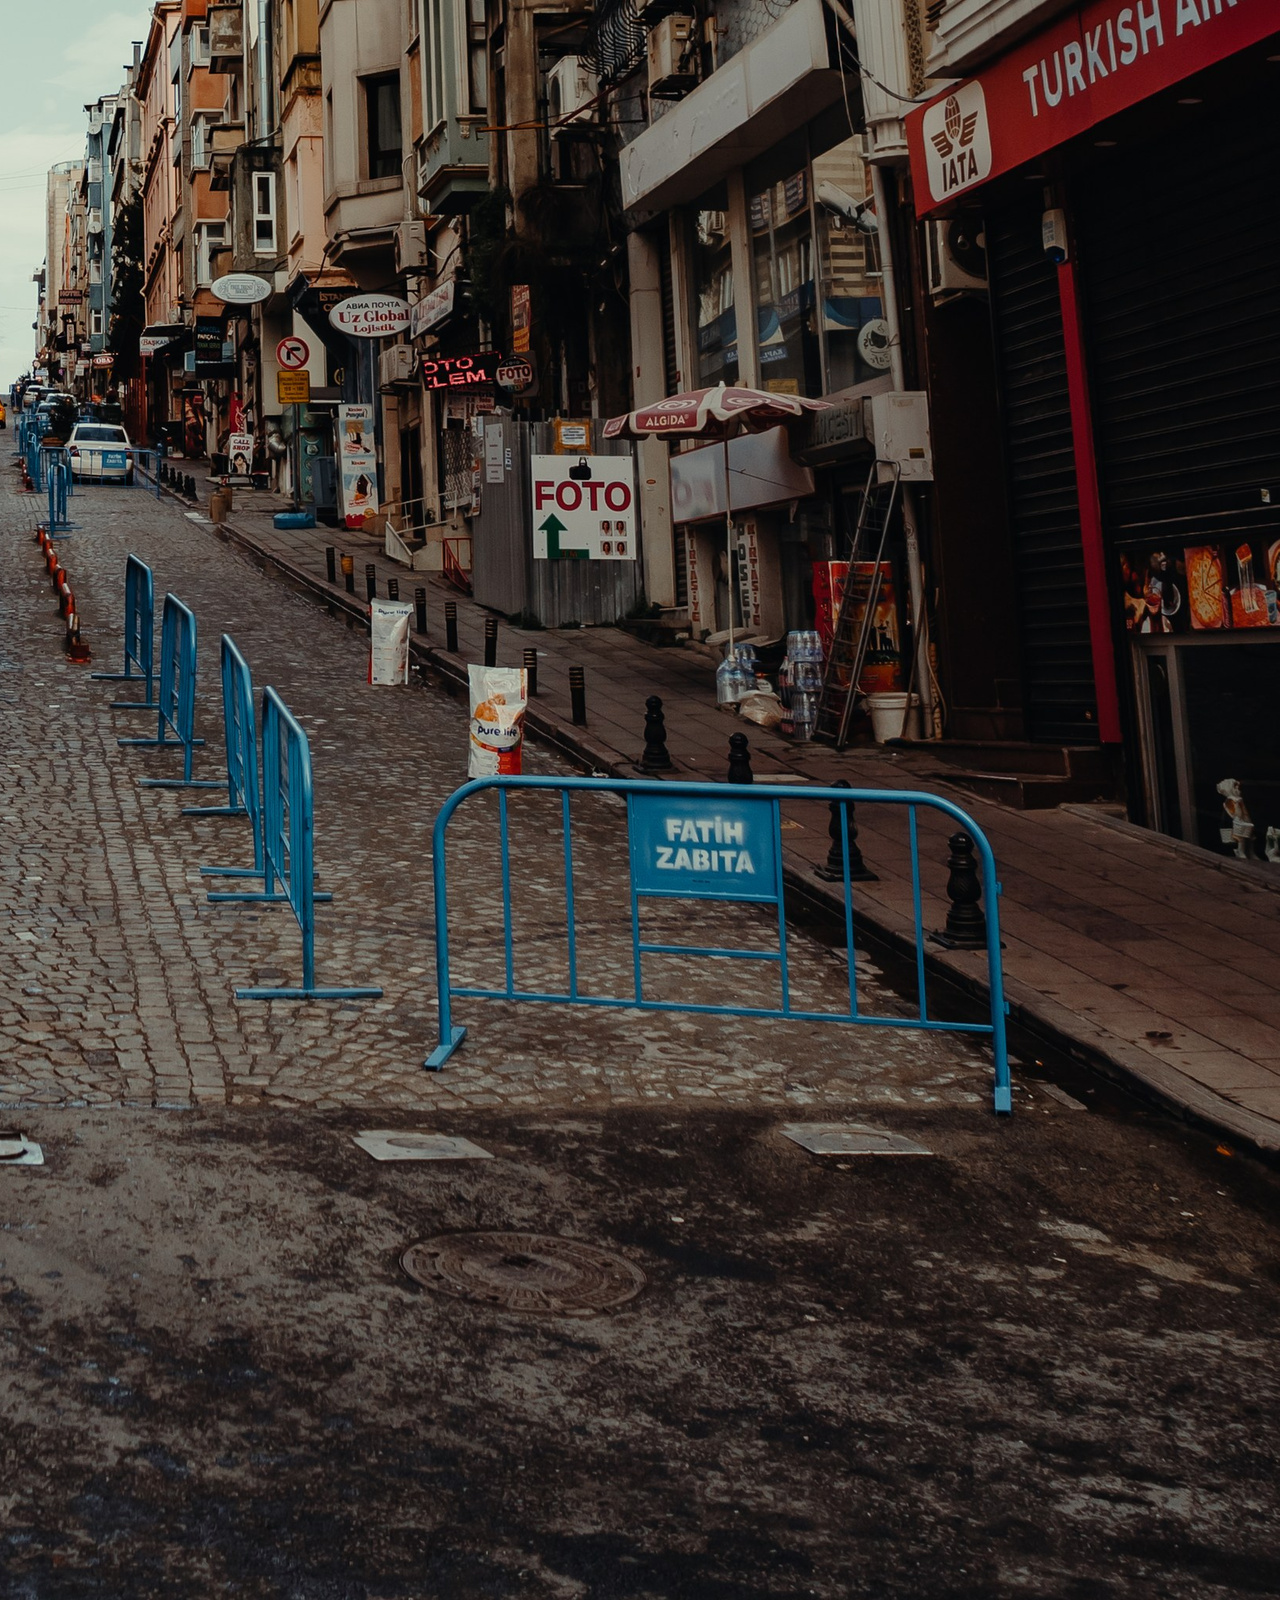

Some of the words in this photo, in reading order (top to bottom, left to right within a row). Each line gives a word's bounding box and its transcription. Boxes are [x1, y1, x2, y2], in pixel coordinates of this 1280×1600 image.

[942, 148, 979, 193] IATA
[338, 311, 361, 323] Uz
[364, 309, 410, 322] Global
[353, 324, 396, 334] Lojistik
[498, 366, 531, 380] FOTO
[535, 481, 632, 512] FOTO
[477, 725, 501, 737] Pure
[665, 815, 744, 846] FATİH
[655, 845, 756, 875] ZABITA
